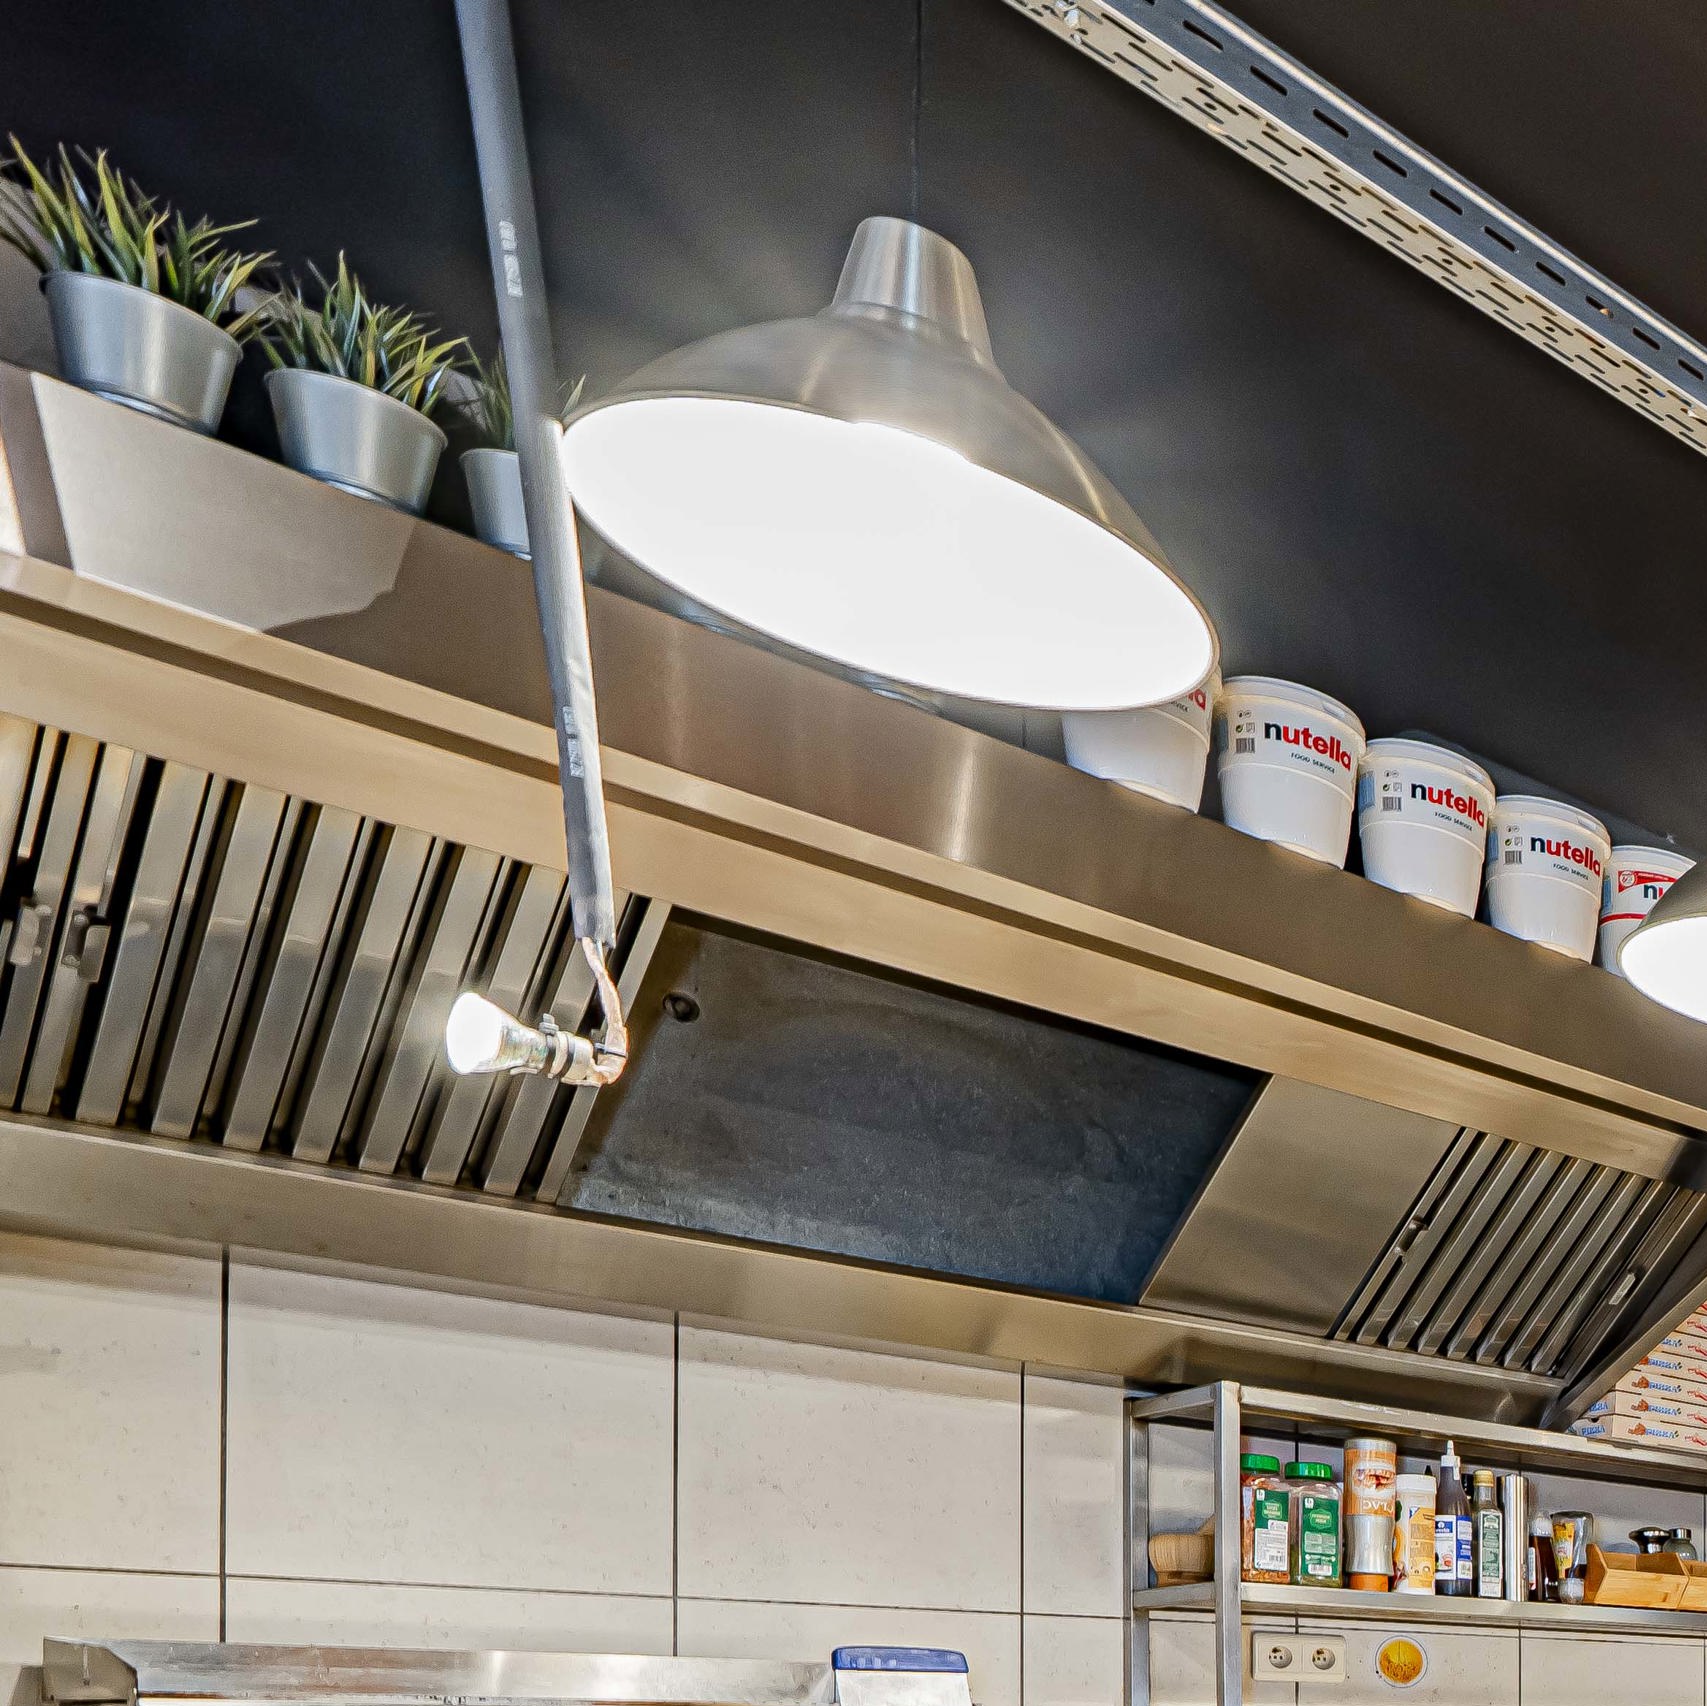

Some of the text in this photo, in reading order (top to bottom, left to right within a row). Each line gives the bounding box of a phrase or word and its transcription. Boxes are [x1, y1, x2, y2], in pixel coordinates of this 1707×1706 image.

[1264, 722, 1351, 771] nutella
[1411, 783, 1485, 828] nutella
[1530, 836, 1601, 876] nutella
